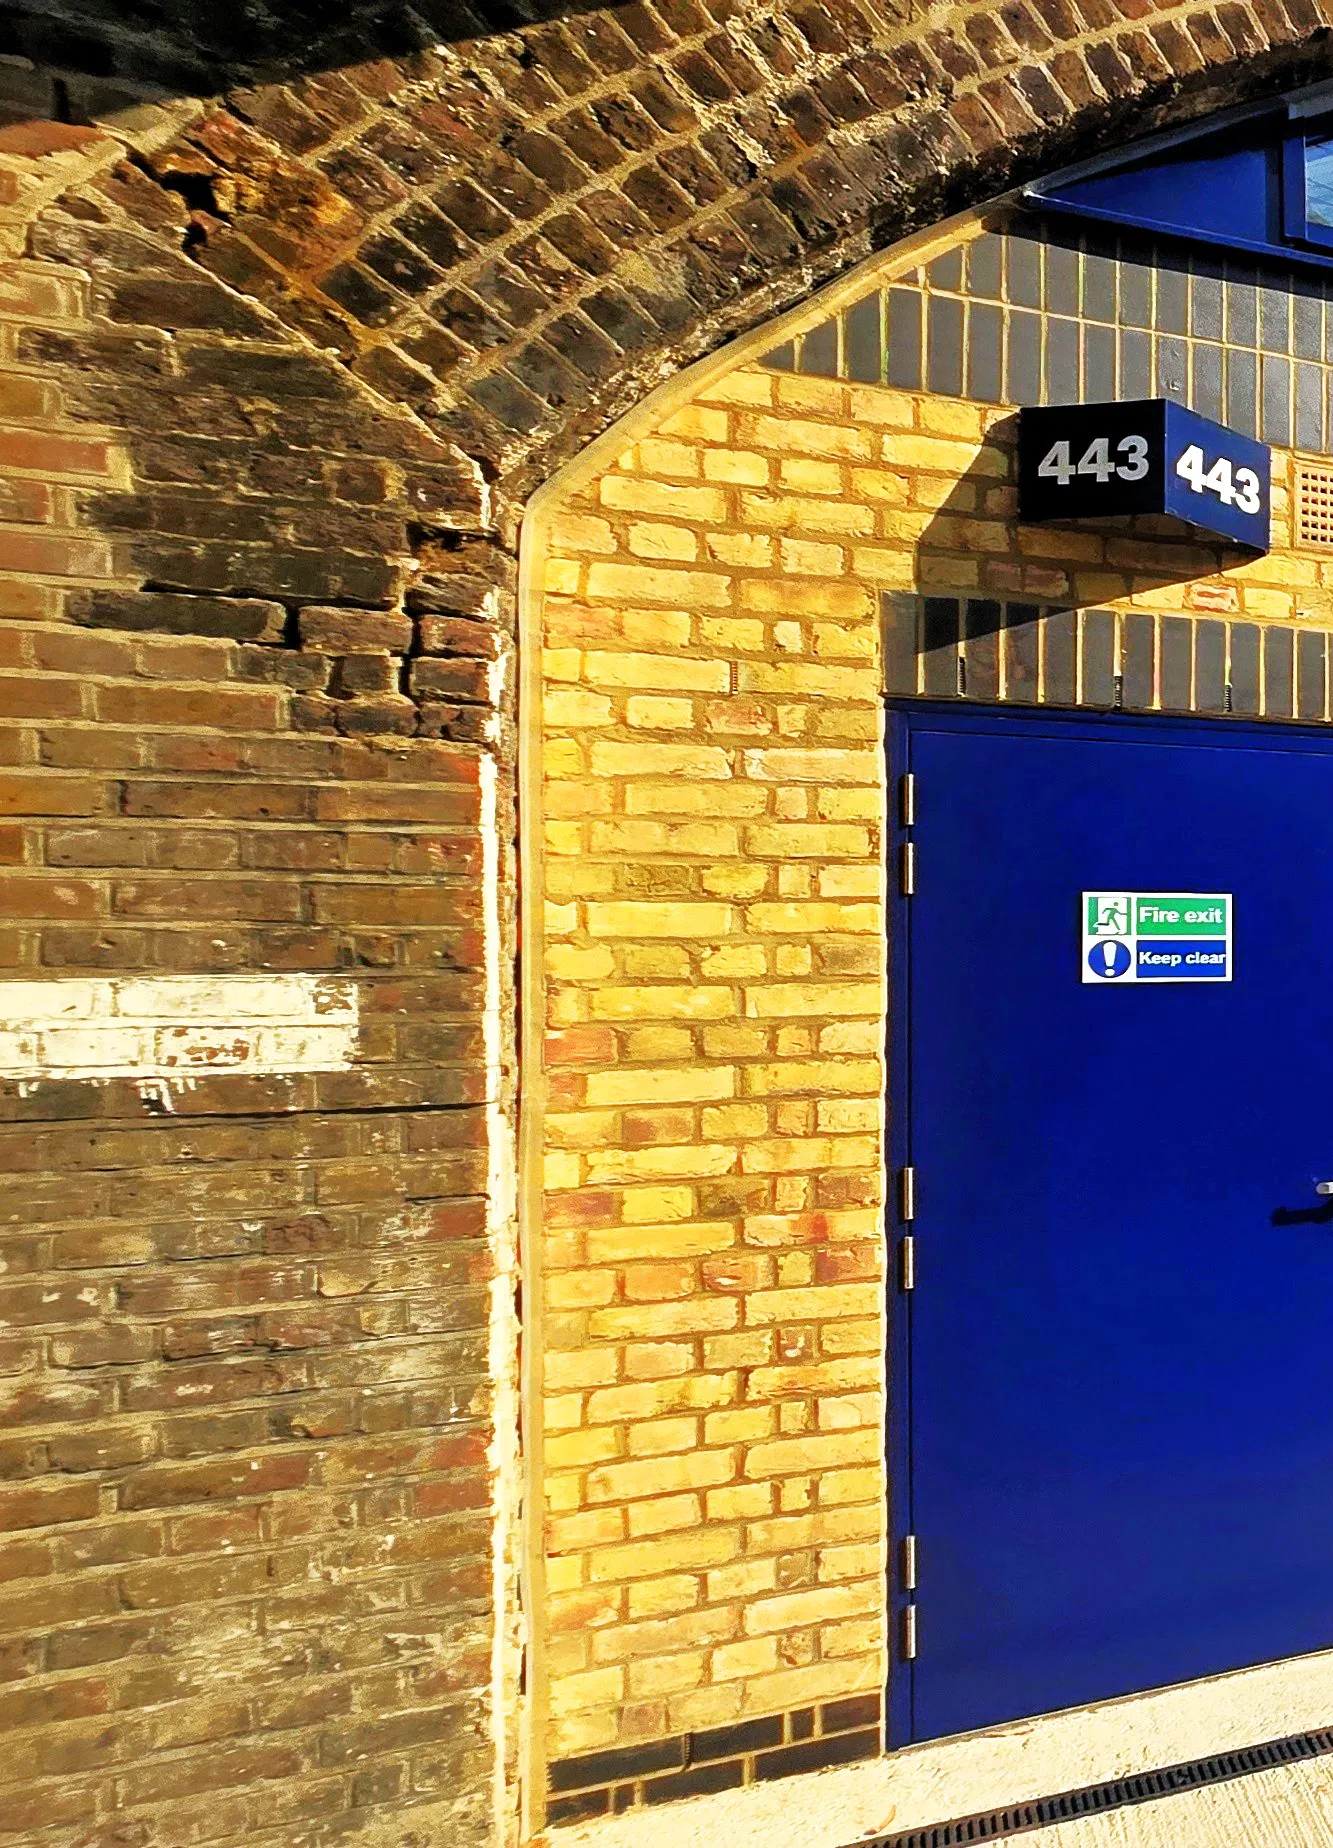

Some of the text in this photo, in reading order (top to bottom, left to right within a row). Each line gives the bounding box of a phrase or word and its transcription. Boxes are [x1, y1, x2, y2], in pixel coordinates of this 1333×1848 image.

[1038, 434, 1150, 485] 443
[1176, 444, 1261, 515] 443
[1139, 906, 1223, 923] Fire exit
[1139, 951, 1227, 967] Keep clear
